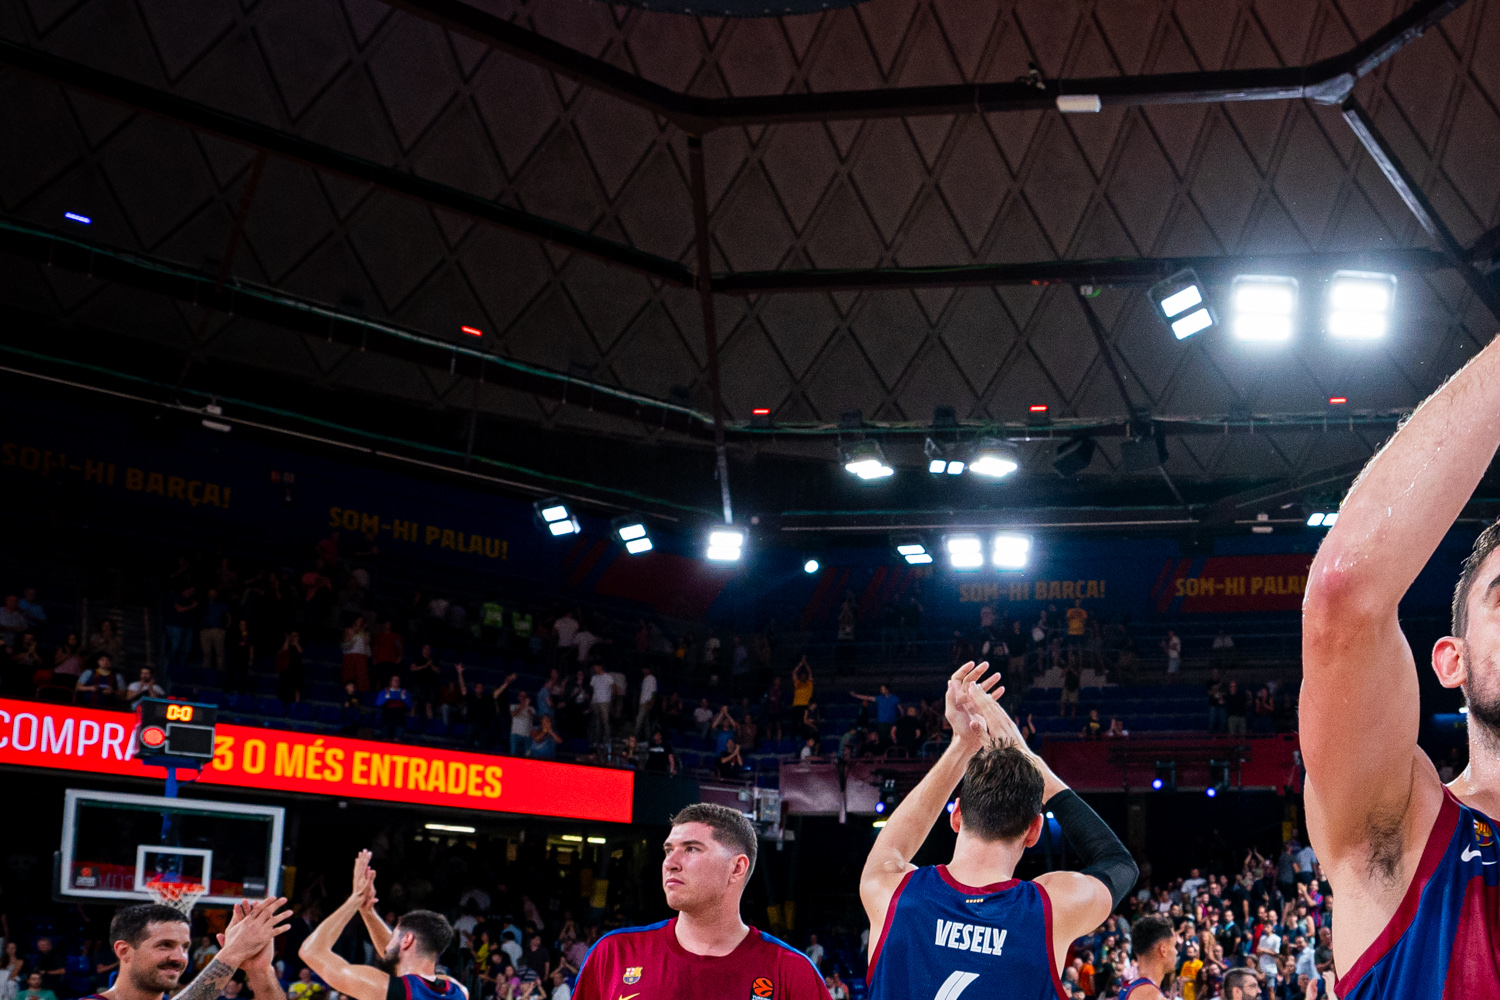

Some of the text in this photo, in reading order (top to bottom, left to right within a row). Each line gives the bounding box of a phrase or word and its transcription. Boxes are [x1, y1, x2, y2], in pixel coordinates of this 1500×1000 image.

[125, 466, 232, 509] BARÇA!
[328, 506, 508, 560] SOM-HI PALAU!
[1175, 575, 1245, 597] SOM-HI
[212, 735, 235, 771] 3
[274, 738, 345, 782] MÉS
[352, 751, 503, 798] ENTRADES
[935, 918, 1008, 956] VESELY
